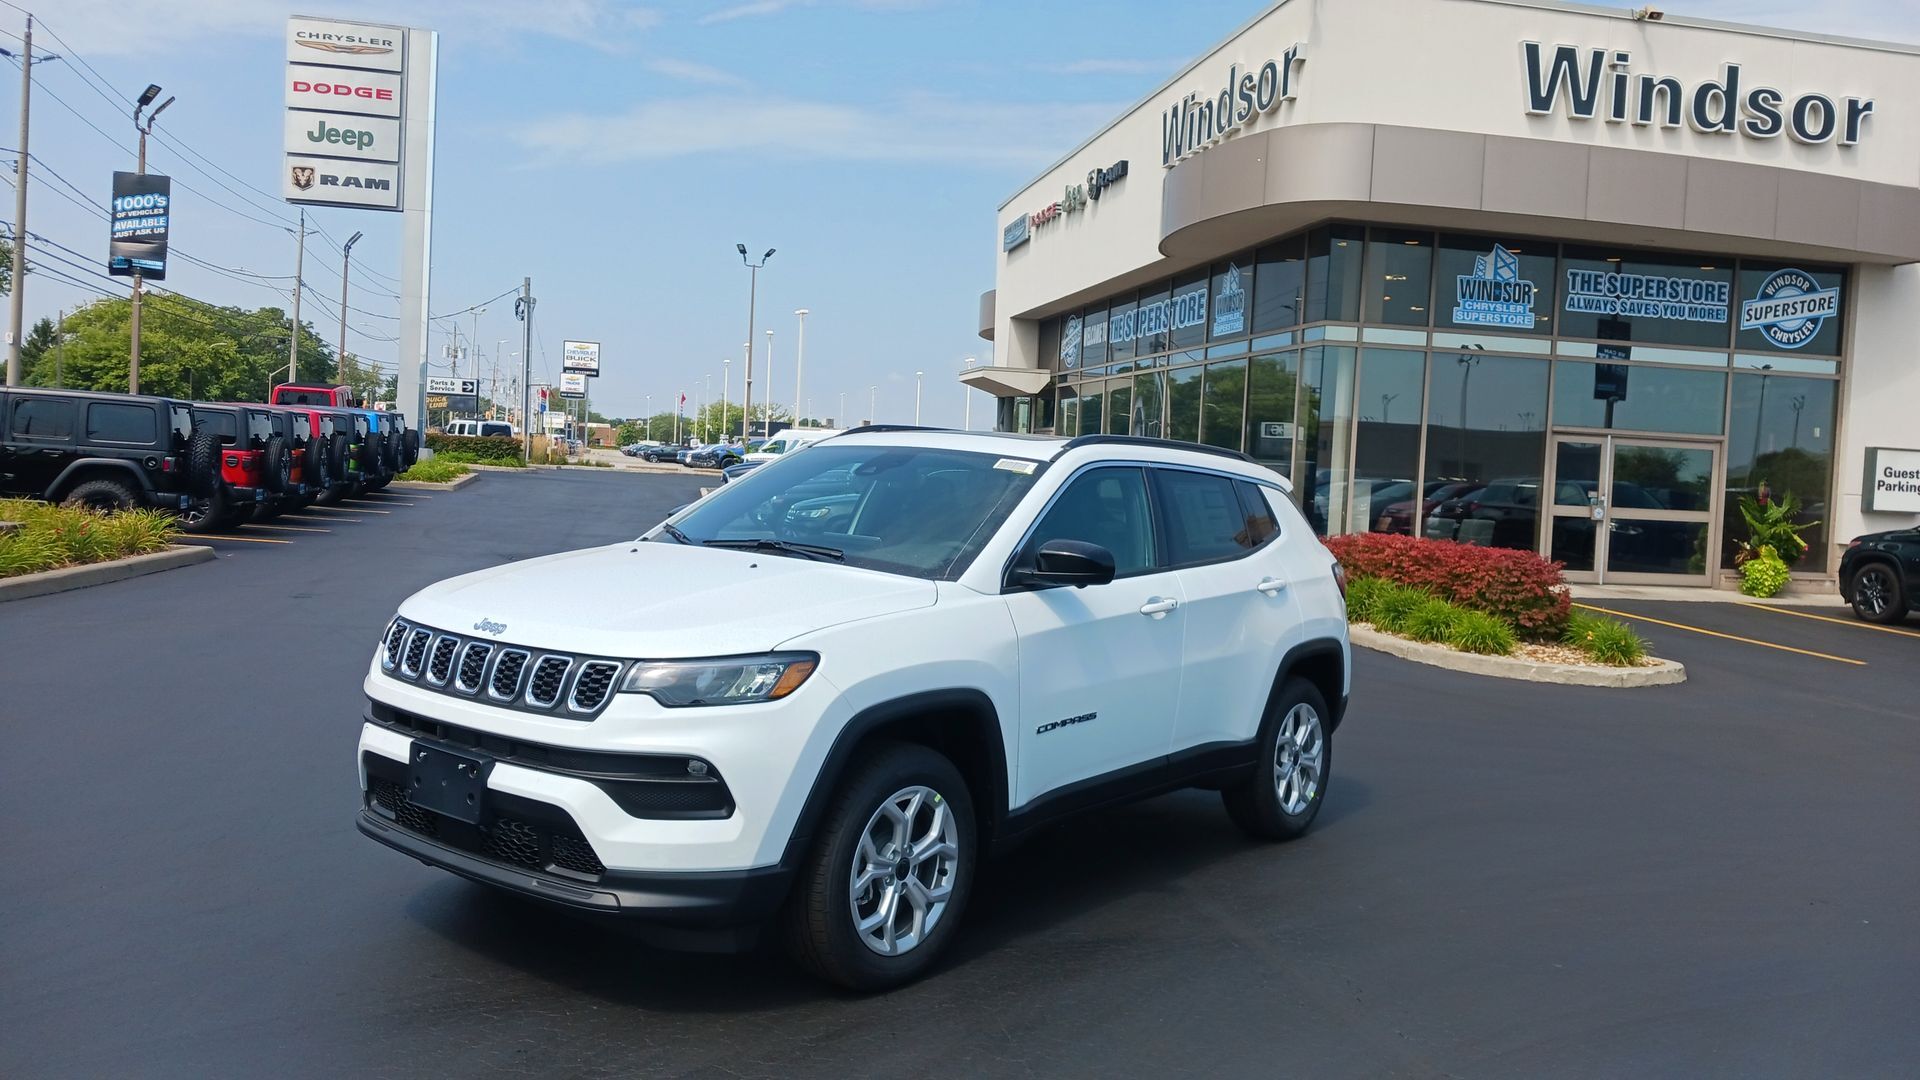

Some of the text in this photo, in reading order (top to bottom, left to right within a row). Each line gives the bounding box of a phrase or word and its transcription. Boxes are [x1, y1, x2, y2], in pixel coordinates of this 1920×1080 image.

[296, 31, 393, 47] CHRYSLER
[293, 80, 393, 101] DODGE
[1521, 40, 1874, 147] Windsor
[1162, 42, 1302, 168] Windsor
[307, 120, 374, 150] Jeep
[320, 174, 390, 191] RAM
[114, 195, 167, 210] 1000's
[128, 208, 164, 217] VEHICLES
[113, 229, 133, 238] JUST
[135, 228, 152, 236] ASK
[114, 218, 166, 230] AVAILABLE
[1459, 279, 1532, 304] WINDSOR
[1568, 271, 1728, 303] THE SUPERSTORE
[1765, 274, 1810, 296] WINDSOR
[1110, 315, 1124, 342] THE
[1124, 292, 1206, 341] SUPERSTORE
[1465, 301, 1524, 313] CHRYSLER
[1567, 295, 1727, 321] ALWAYS SAVES YOU MORE!
[1745, 296, 1835, 322] SUPERSTORE
[1456, 311, 1532, 325] SUPERSTORE
[1770, 320, 1815, 343] CHRYSLER
[1883, 466, 1920, 480] Guest
[473, 617, 508, 637] Jeep
[1036, 711, 1098, 735] COMPASS
